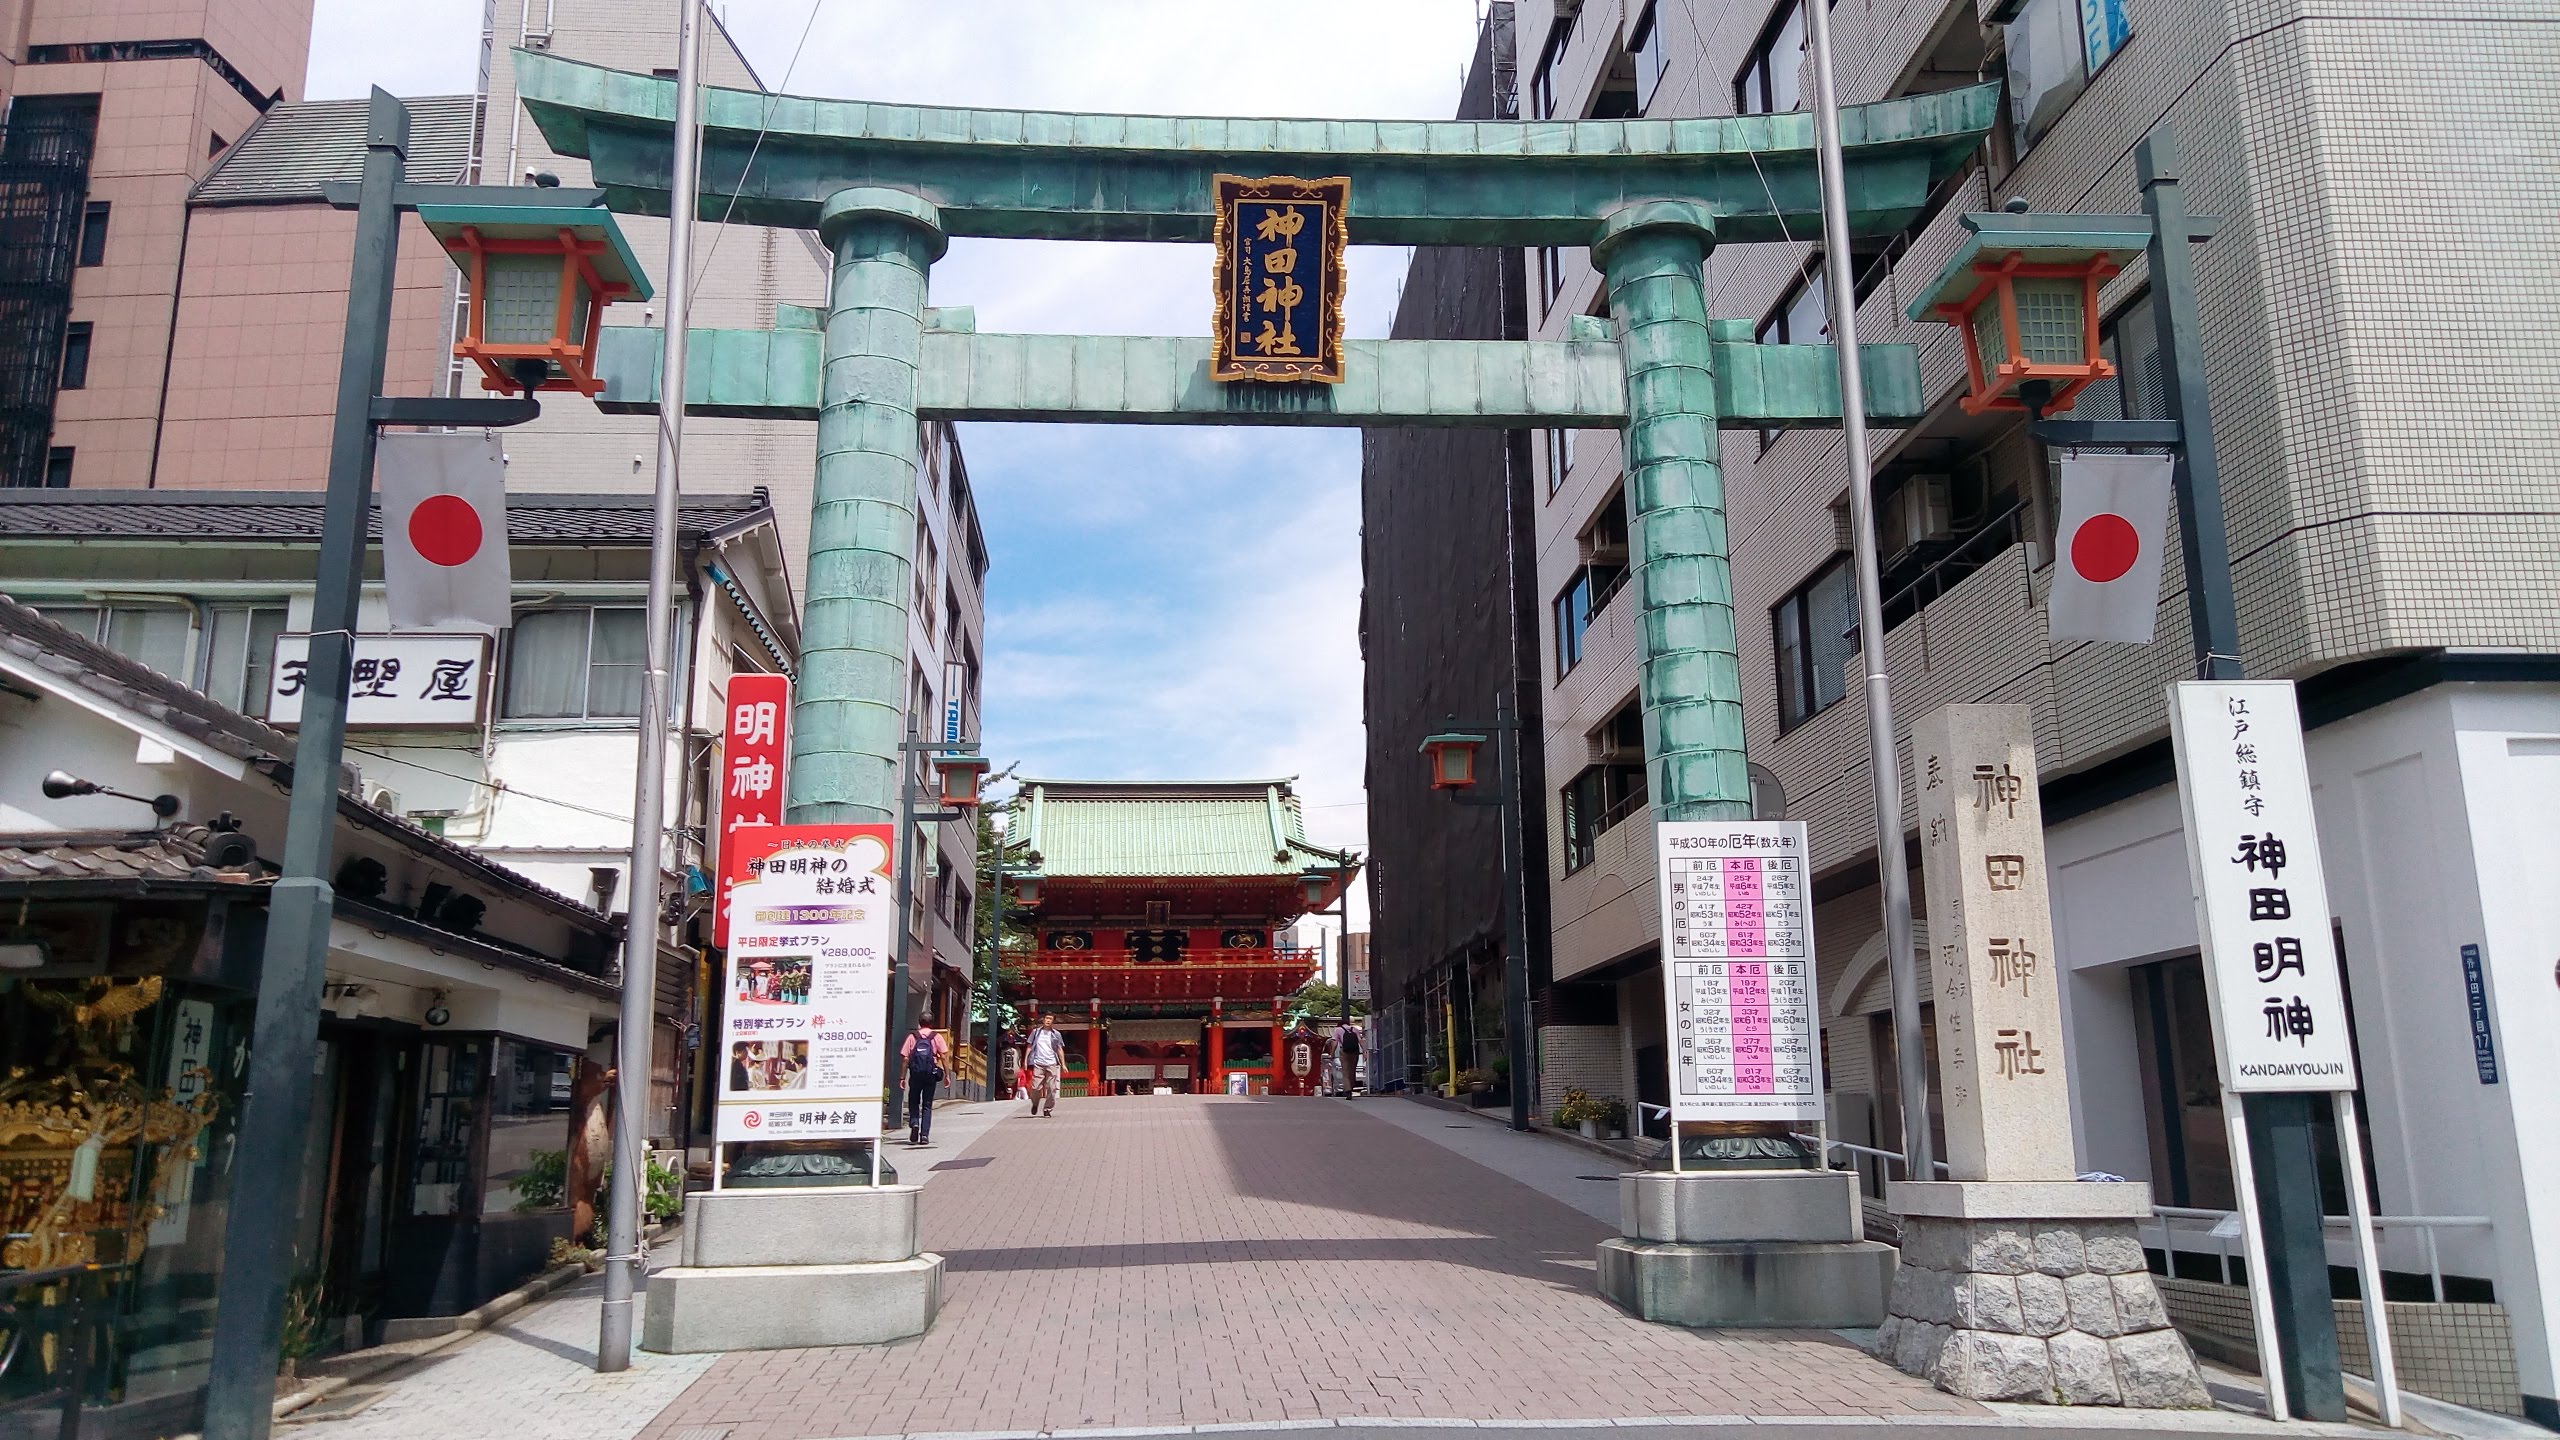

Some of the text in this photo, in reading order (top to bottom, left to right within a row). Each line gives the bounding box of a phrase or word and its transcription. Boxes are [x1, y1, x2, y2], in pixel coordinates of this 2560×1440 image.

[1256, 205, 1304, 355] 神田神社
[2228, 696, 2265, 817] 江戸総鎮守
[1669, 833, 1797, 849] 平成30年の厄年(数え年)
[746, 856, 848, 876] 神田明神の
[1693, 860, 1717, 870] 前厄
[1730, 860, 1754, 870] 本厄
[1768, 860, 1792, 870] 後厄
[815, 877, 876, 894] 結婚式
[1673, 883, 1687, 946] 男の厄年
[1972, 763, 2045, 1081] 神田神社
[737, 936, 830, 948] 平日限定挙式プラン
[1692, 939, 1726, 947] 昭和34年生
[2231, 831, 2314, 1048] 神田明神
[1698, 965, 1722, 975] 前厄
[1736, 965, 1760, 974] 本厄
[1774, 964, 1798, 974] 後厄
[1695, 987, 1728, 995] 平成13年生
[1733, 987, 1766, 995] 平成12年生
[1771, 987, 1804, 995] 平成11年生
[732, 1018, 806, 1030] 特別挙式プラン
[1696, 1016, 1730, 1024] 昭和62年生
[1734, 1016, 1768, 1024] 昭和61年生
[1772, 1016, 1806, 1024] 昭和60年生
[1679, 1001, 1693, 1066] 女の厄年
[2239, 1062, 2344, 1077] KANDAMYOUJIN
[799, 1110, 858, 1125] 明神会館
